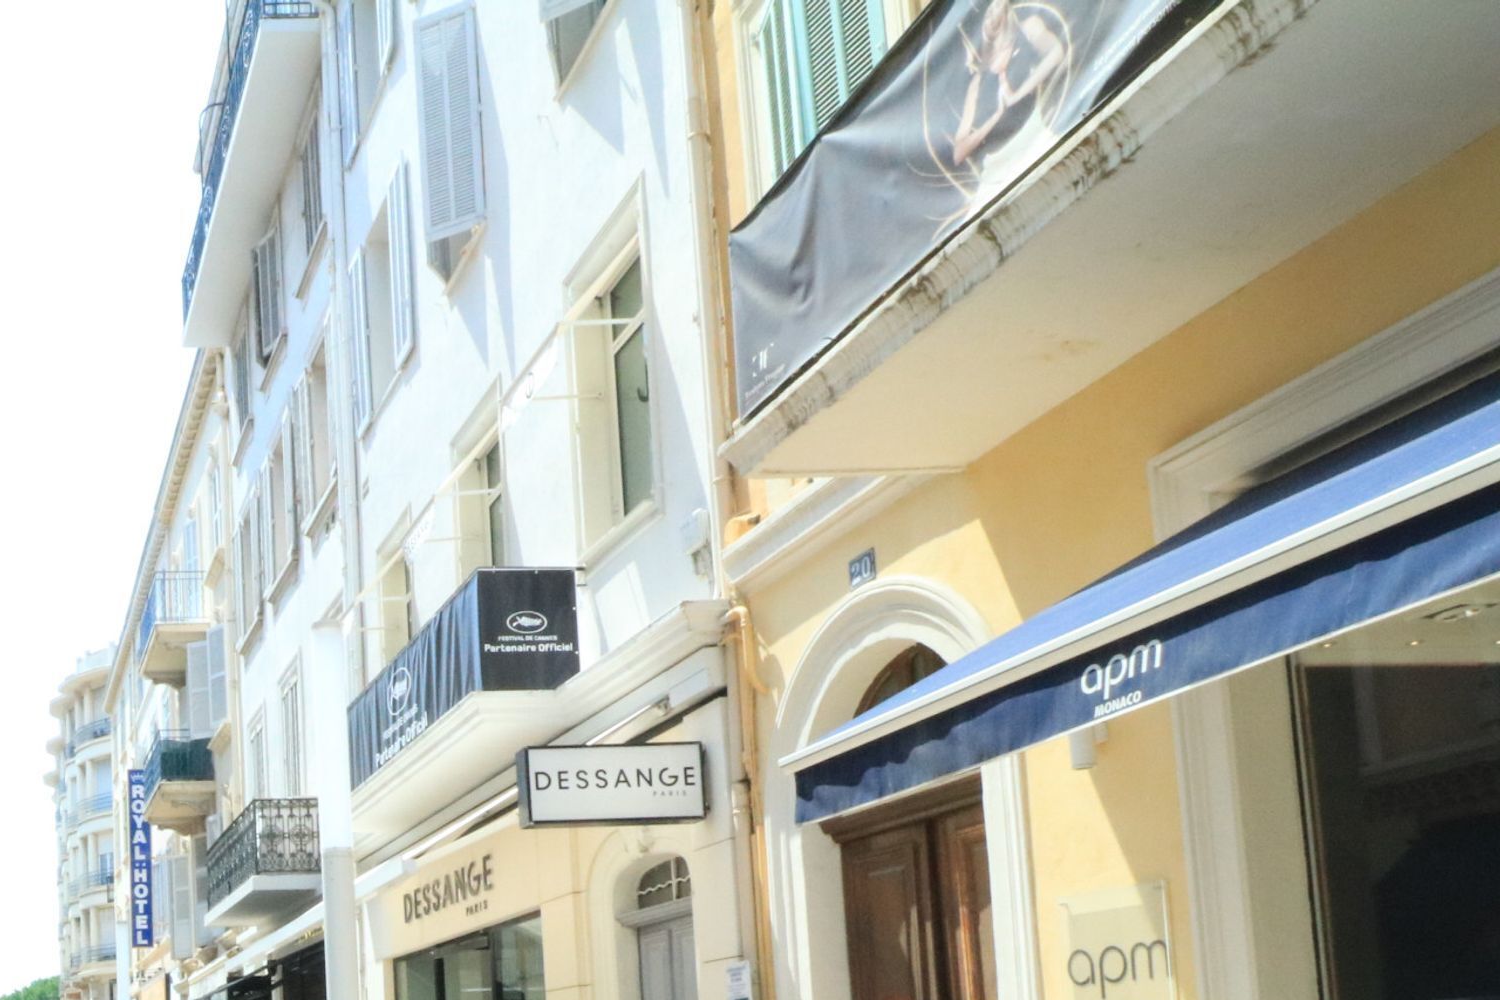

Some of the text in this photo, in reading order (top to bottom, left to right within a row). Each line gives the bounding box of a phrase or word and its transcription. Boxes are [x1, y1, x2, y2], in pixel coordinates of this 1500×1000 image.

[851, 556, 871, 586] 20
[484, 642, 573, 653] Partenaire Officiel
[1080, 639, 1162, 700] apm
[1094, 690, 1142, 718] MONACO
[534, 766, 696, 791] DESSANGE
[652, 789, 688, 797] PARIS
[131, 784, 148, 860] ROYAL
[403, 853, 494, 923] DESSANGE
[133, 868, 149, 945] HOTEL
[466, 899, 488, 916] PARIS
[1067, 939, 1170, 1000] apm
